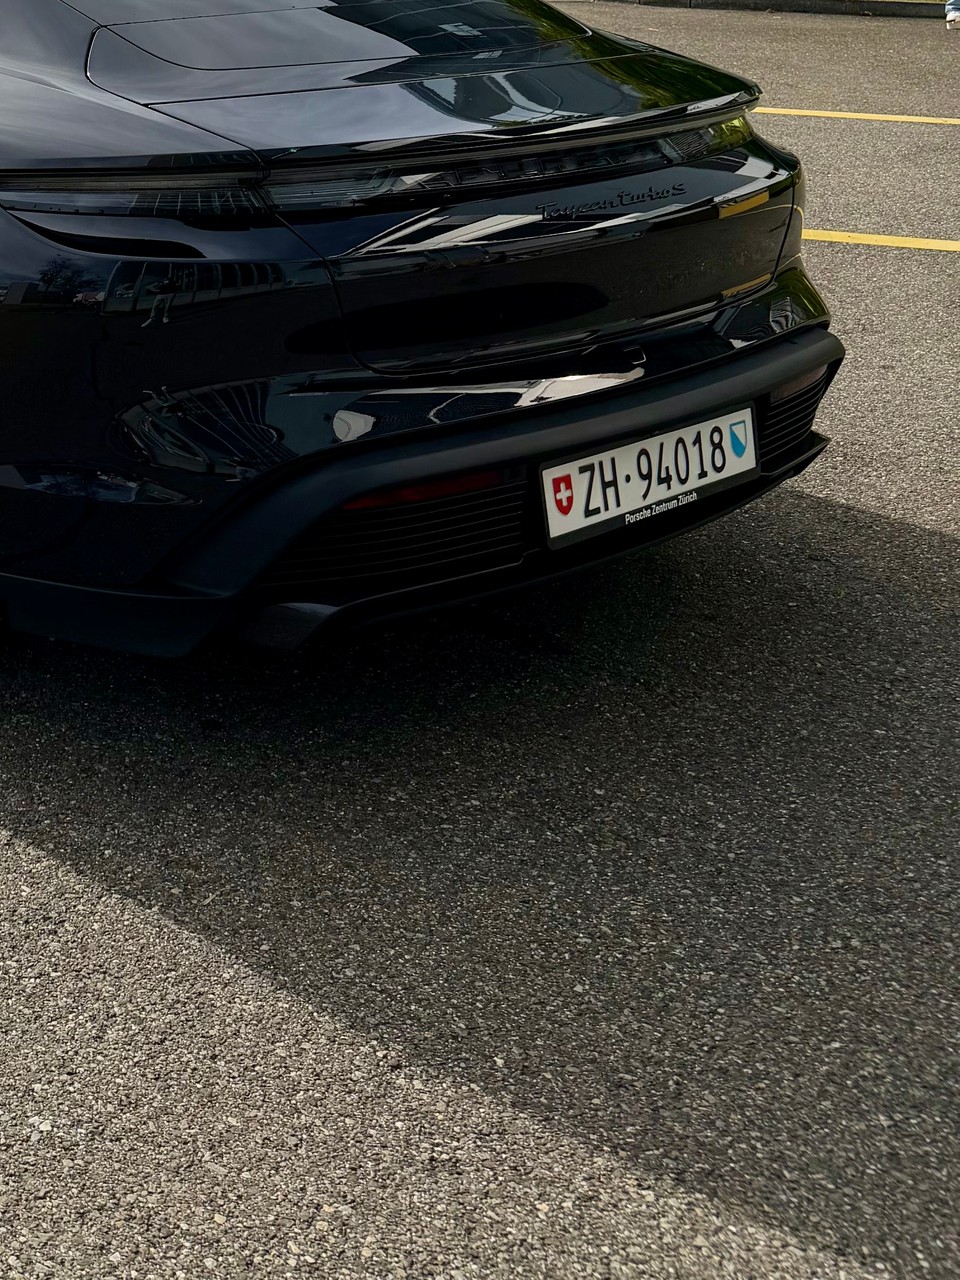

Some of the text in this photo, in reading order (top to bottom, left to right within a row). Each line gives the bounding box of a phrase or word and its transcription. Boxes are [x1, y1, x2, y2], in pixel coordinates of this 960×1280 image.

[625, 491, 698, 525] Porsche Zentrum Zürich
